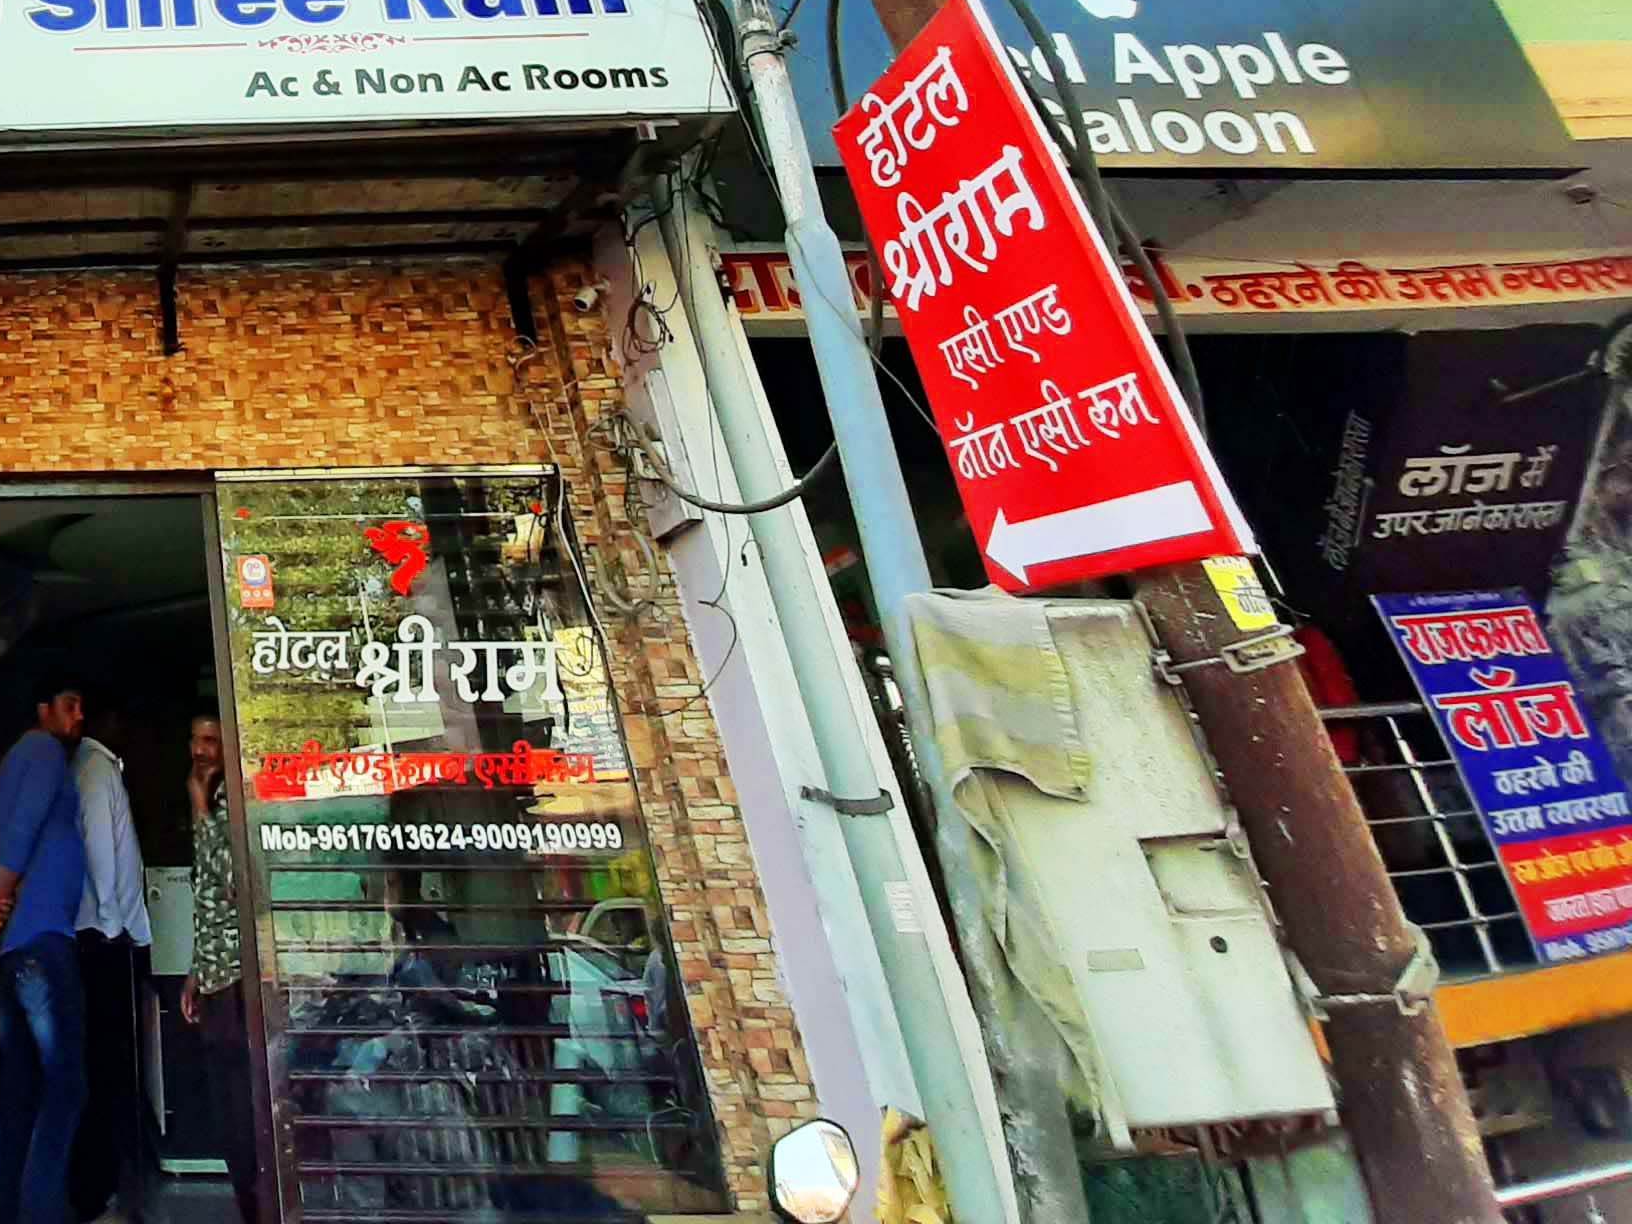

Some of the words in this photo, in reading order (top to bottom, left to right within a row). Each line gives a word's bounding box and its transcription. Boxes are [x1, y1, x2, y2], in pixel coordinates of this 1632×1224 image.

[245, 70, 303, 100] Ac
[311, 66, 343, 97] &
[355, 65, 447, 97] Non
[457, 62, 513, 93] Ac
[522, 61, 670, 92] Rooms
[1113, 31, 1352, 100] Apple
[856, 44, 970, 189] होटल
[1201, 263, 1334, 309] ठहरने
[1328, 260, 1389, 302] की
[1385, 262, 1496, 302] उत्तम
[938, 304, 1006, 391] एसी
[994, 284, 1072, 363] एण्ड
[949, 411, 1021, 480] नॉन
[1009, 379, 1092, 473] एसी
[1077, 372, 1160, 438] रूम
[1397, 443, 1523, 497] लॉज
[250, 616, 353, 675] होटल
[355, 614, 444, 704] श्री
[448, 639, 565, 704] राम
[1390, 605, 1551, 664] राजकमल
[1433, 666, 1591, 751] लॉज
